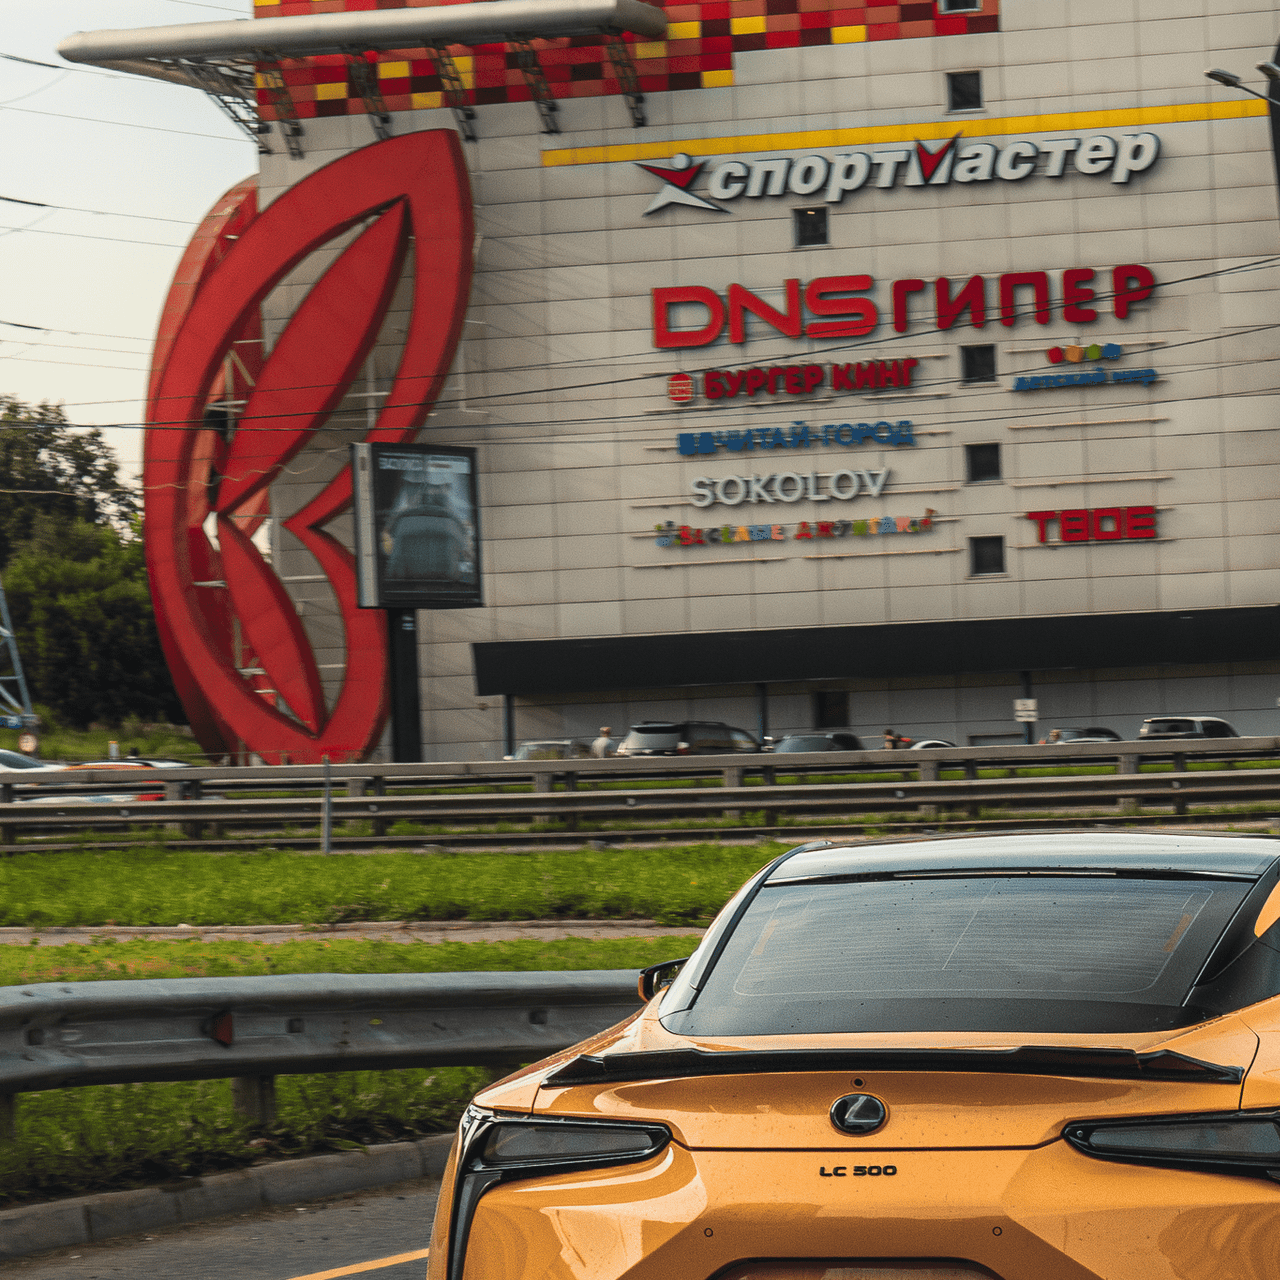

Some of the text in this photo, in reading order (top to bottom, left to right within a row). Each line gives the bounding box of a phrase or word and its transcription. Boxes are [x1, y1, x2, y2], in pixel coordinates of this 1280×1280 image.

[652, 264, 1155, 348] DNS ГИПЕР
[704, 365, 824, 399] БУРГЕР
[832, 358, 918, 391] КИНГ
[690, 468, 891, 507] SOKOLOV
[1027, 505, 1156, 543] ТВОЕ
[819, 1165, 897, 1177] LC 500
